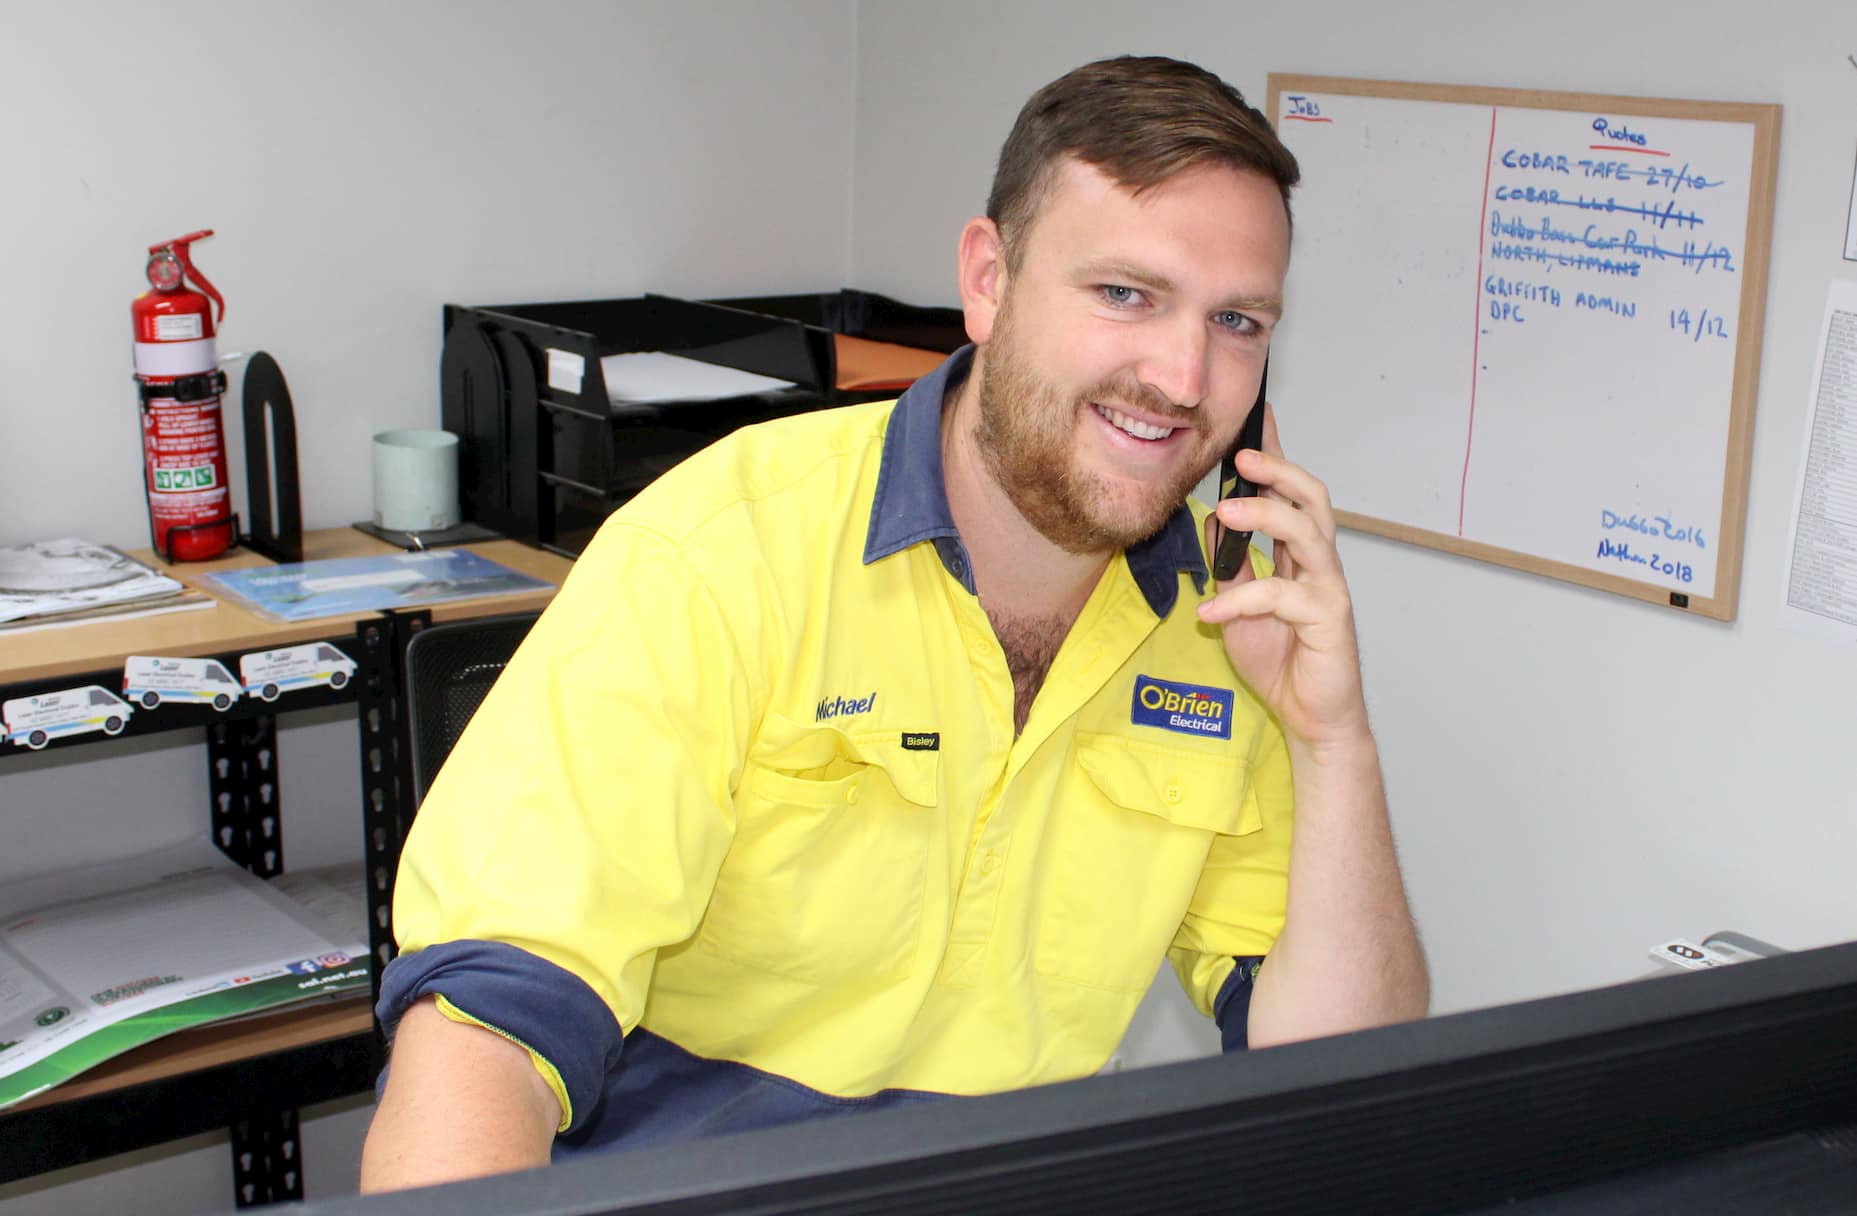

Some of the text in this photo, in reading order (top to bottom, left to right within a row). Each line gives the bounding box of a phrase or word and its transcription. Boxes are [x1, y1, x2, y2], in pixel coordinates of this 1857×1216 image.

[1592, 118, 1647, 145] Quotes
[1502, 150, 1570, 175] COBAR
[1578, 160, 1631, 180] TAFE
[1496, 186, 1561, 205] COBAR
[1485, 275, 1637, 318] GRIFFITH ADMIN
[1490, 301, 1525, 323] DPC
[1669, 308, 1729, 342] 14/12
[815, 692, 877, 722] Michael
[1140, 685, 1224, 718] O'Brien
[1169, 714, 1222, 733] Electrical
[906, 736, 935, 748] Bisley
